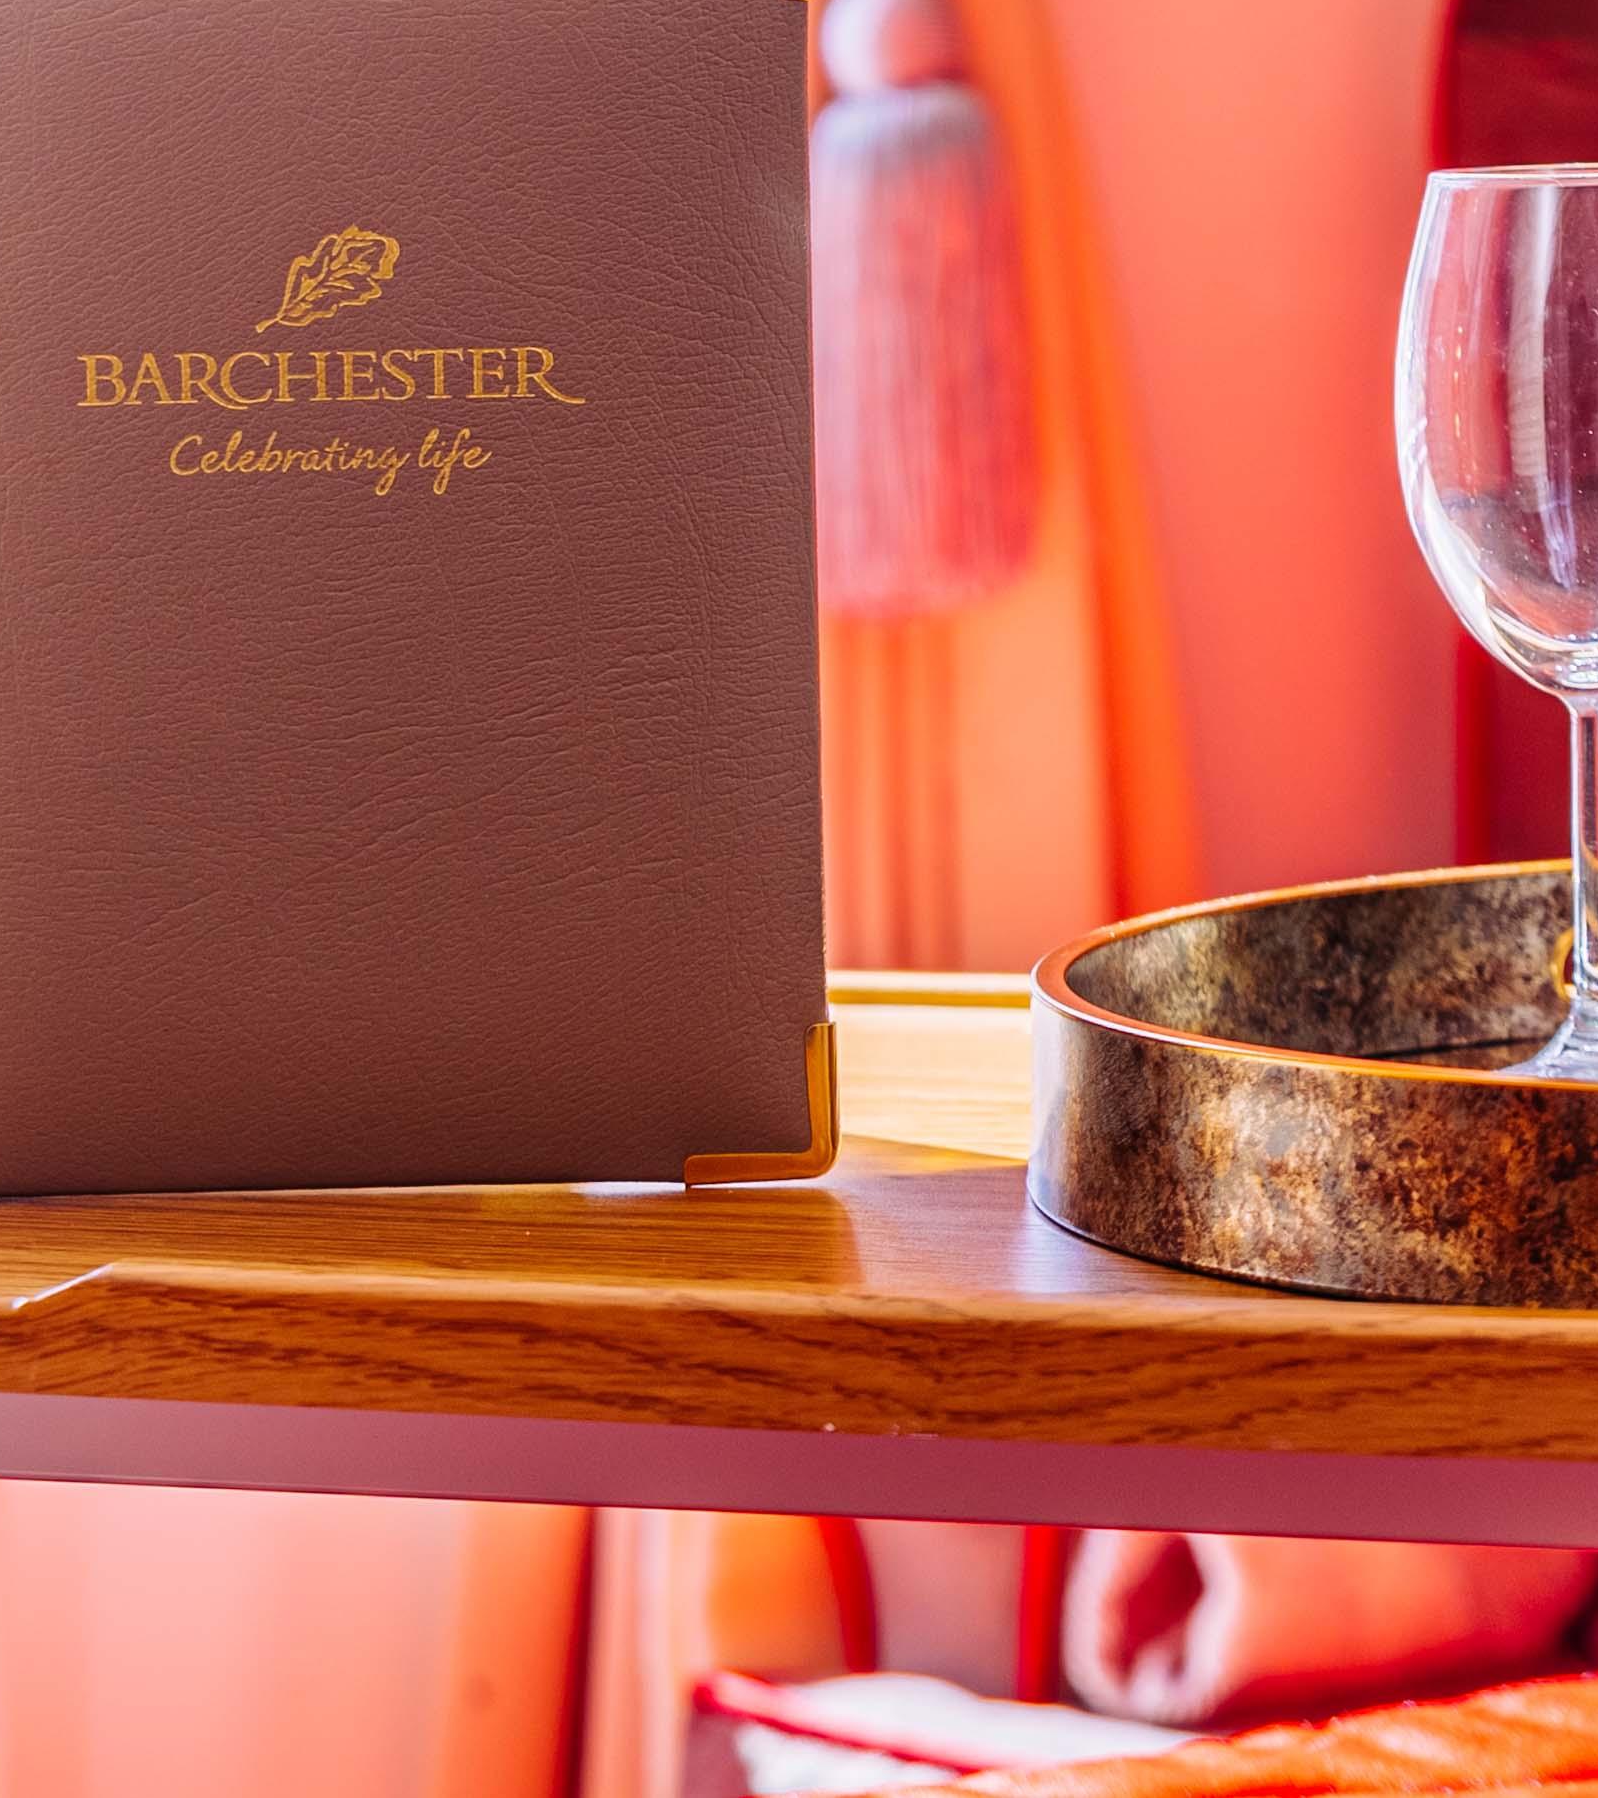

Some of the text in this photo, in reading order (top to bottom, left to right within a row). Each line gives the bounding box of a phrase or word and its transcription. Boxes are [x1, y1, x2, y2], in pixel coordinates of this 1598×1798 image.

[77, 346, 586, 410] BARCHESTER
[170, 427, 492, 495] Celebrating life
